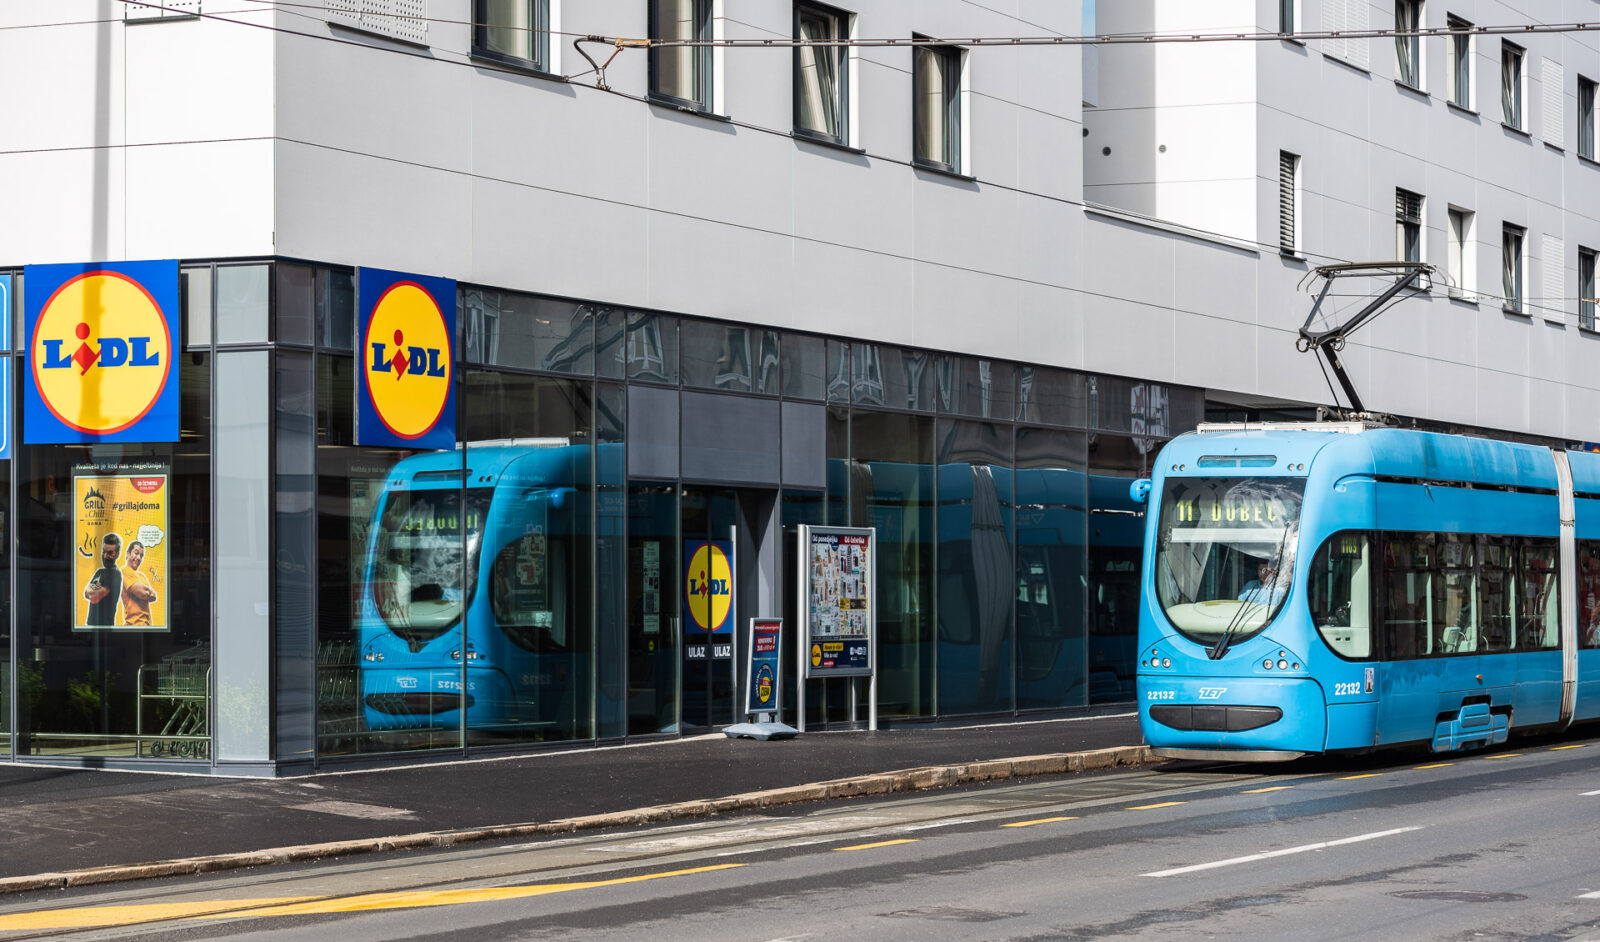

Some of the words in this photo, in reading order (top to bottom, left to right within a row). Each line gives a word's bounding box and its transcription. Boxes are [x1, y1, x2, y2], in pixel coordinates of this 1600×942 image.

[43, 322, 159, 376] LIDL
[371, 329, 445, 381] LIDL
[84, 500, 105, 509] GRILL
[112, 501, 160, 512] #grillajdoma
[88, 510, 105, 518] Chill
[1177, 501, 1193, 521] 11
[1211, 503, 1276, 522] DUBEC
[690, 570, 729, 599] LIDL
[688, 646, 705, 657] ULAZ
[714, 645, 731, 657] ULAZ
[1199, 688, 1228, 699] ZET
[1334, 682, 1360, 696] 22132
[1147, 691, 1175, 700] 22132
